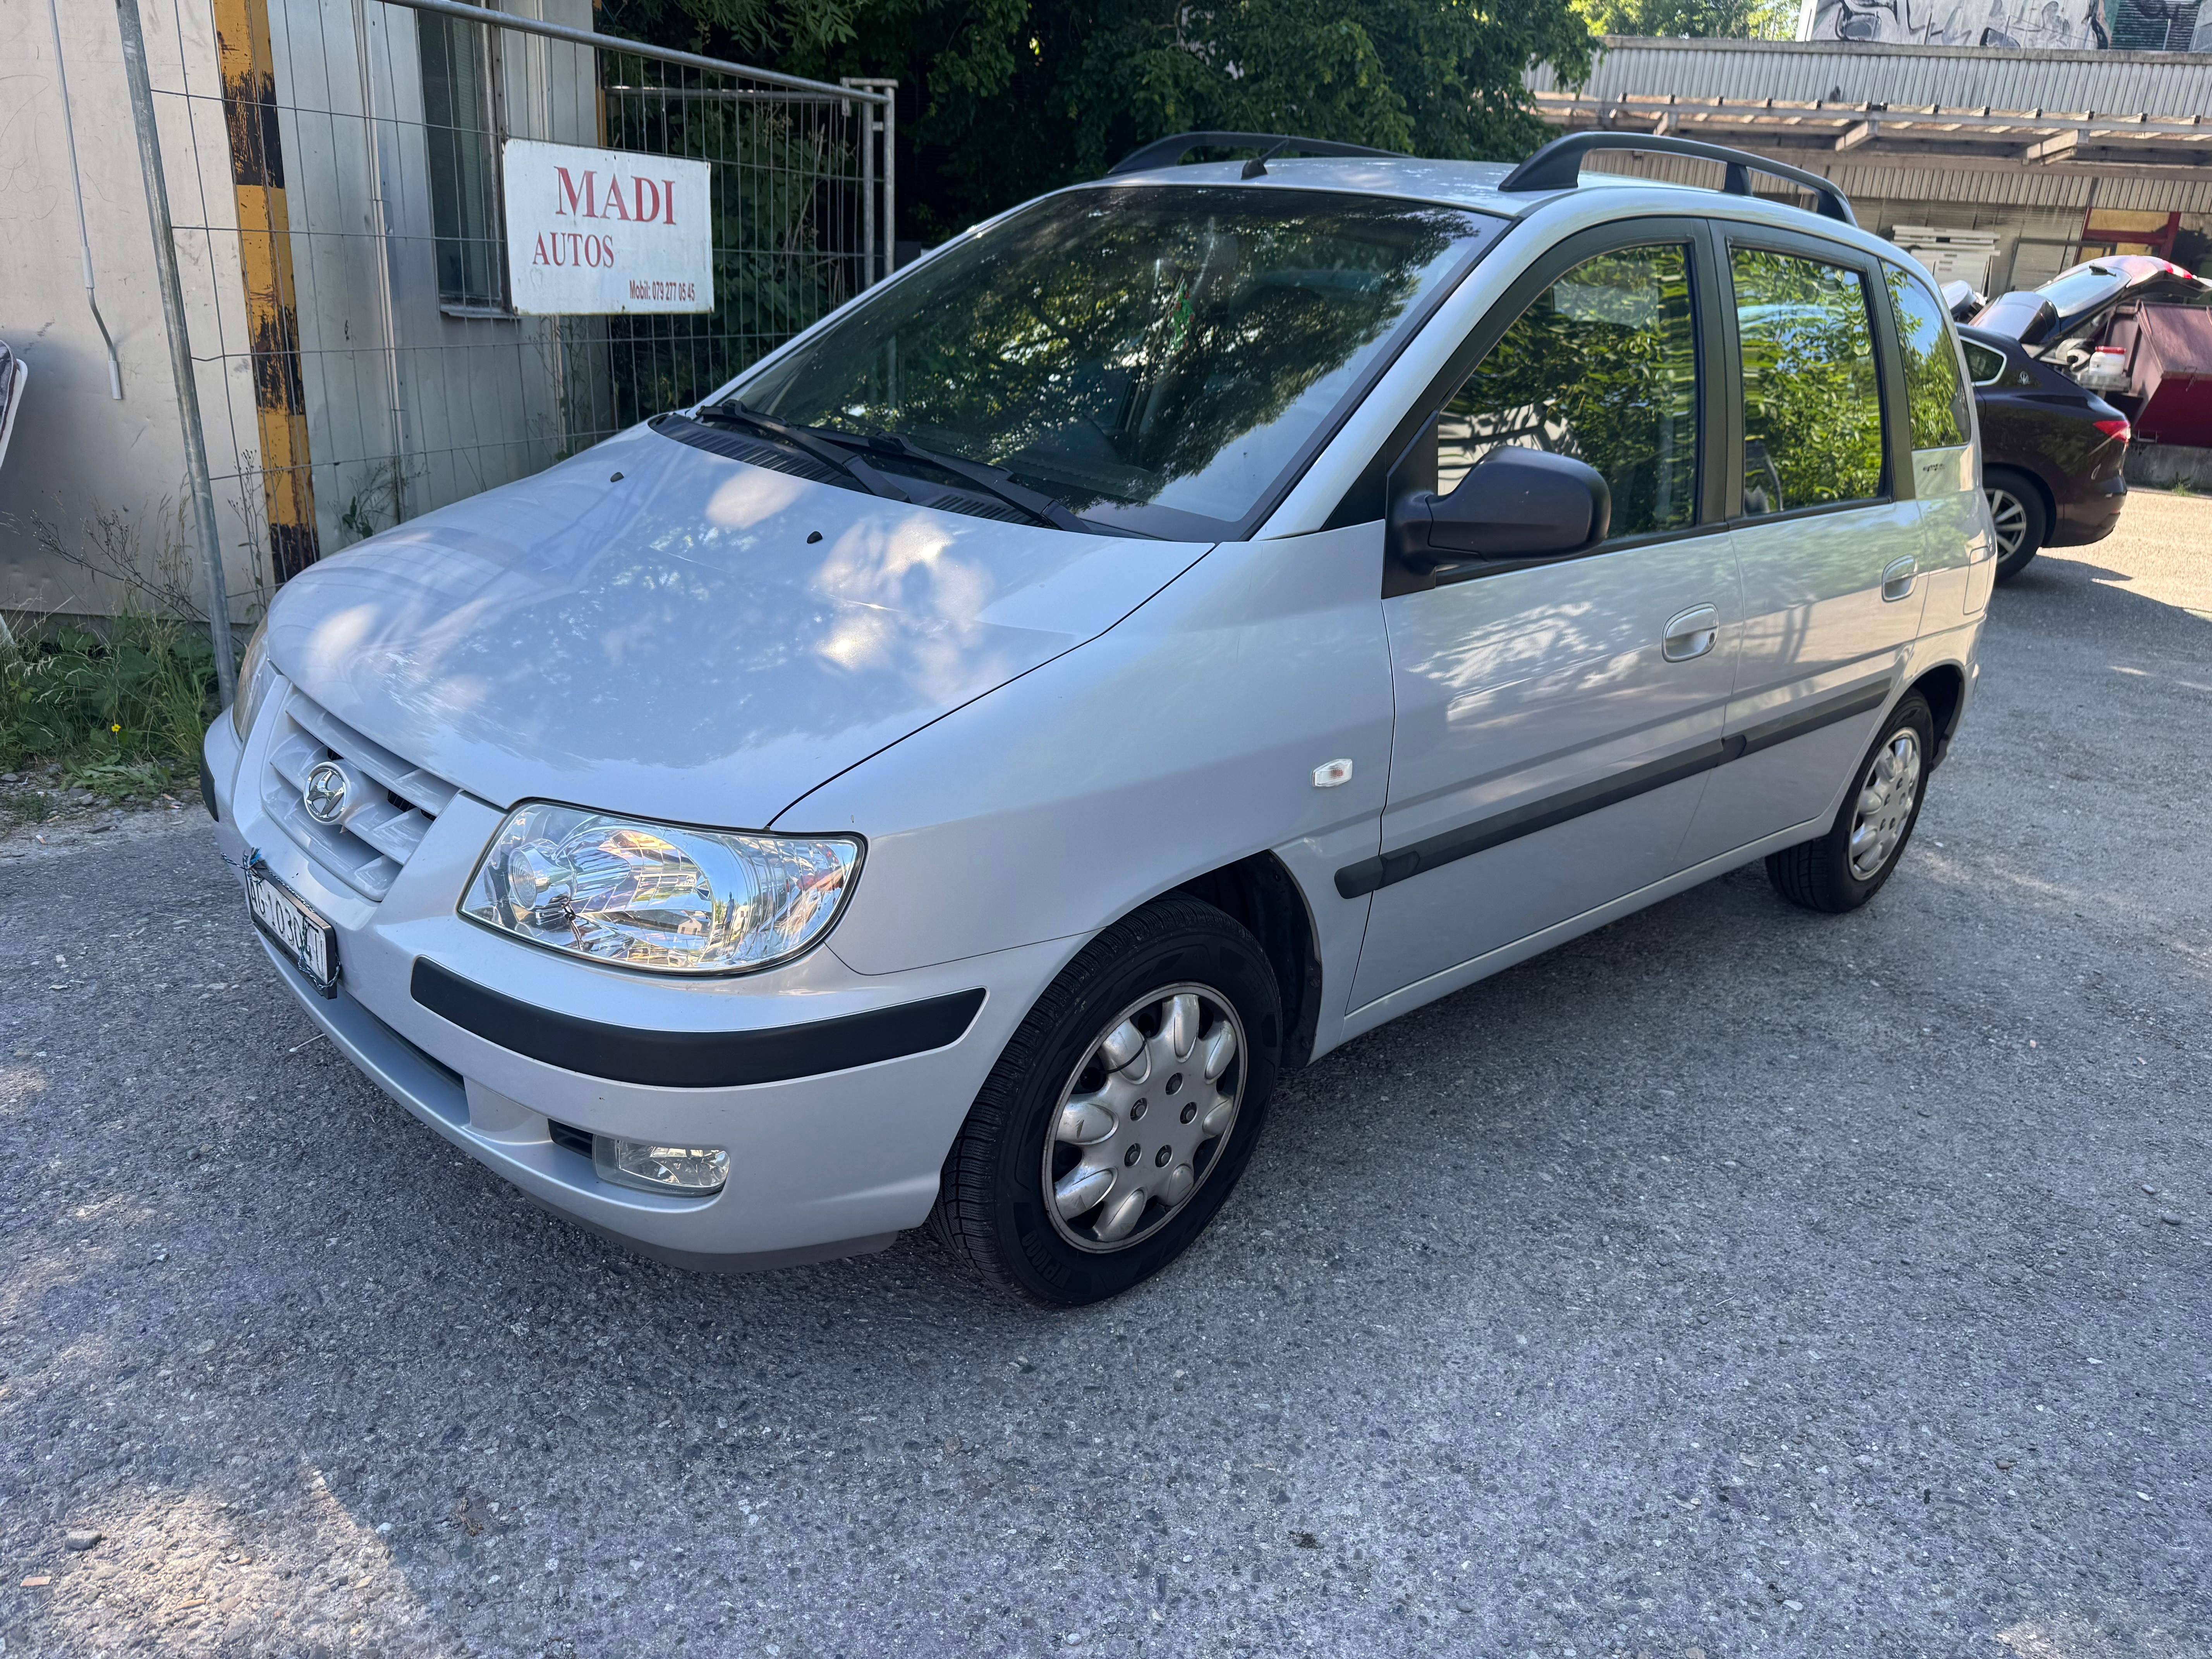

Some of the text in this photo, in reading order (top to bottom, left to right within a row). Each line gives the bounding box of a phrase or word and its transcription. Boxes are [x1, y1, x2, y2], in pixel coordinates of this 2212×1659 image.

[554, 166, 677, 225] MADI
[532, 231, 614, 268] AUTOS
[629, 279, 695, 302] Mobil: 079 277 05 45
[1022, 1229, 1071, 1289] WP1000
